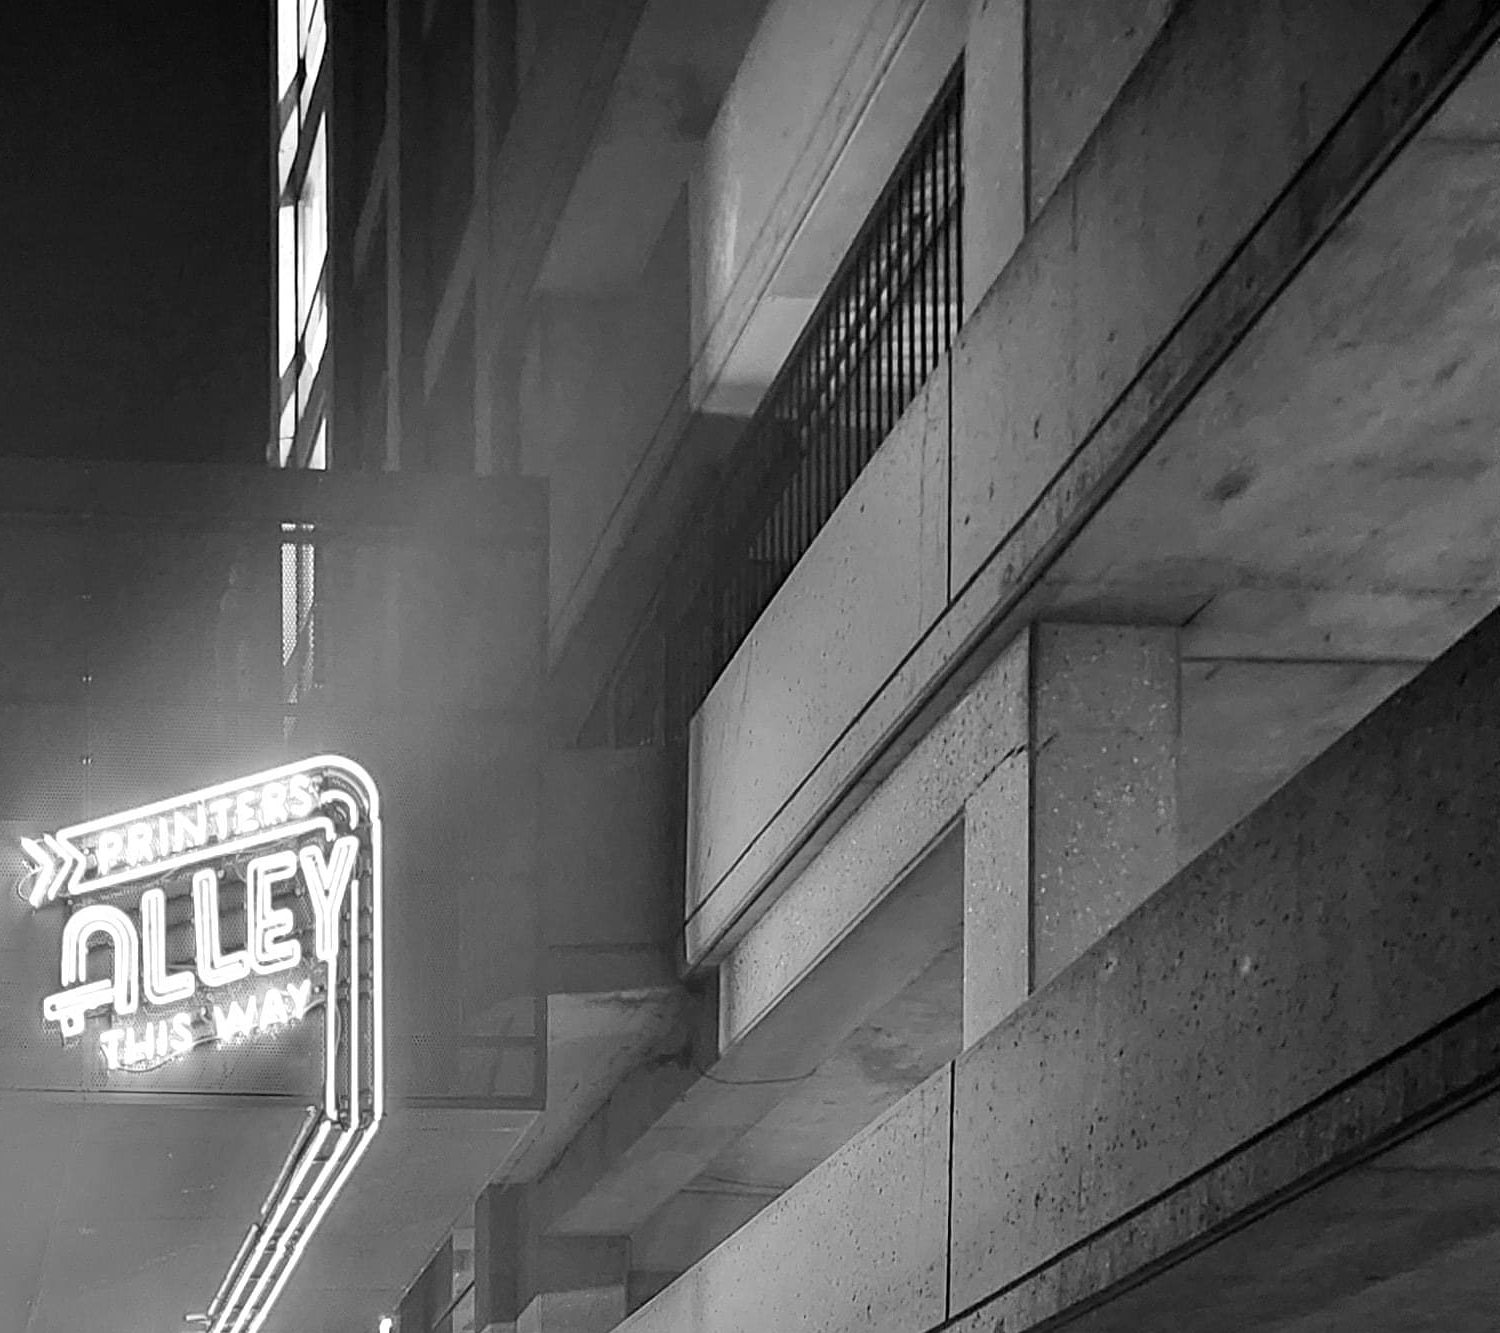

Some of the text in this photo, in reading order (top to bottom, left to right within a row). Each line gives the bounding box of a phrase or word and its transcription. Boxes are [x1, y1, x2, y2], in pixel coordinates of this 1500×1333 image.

[96, 774, 313, 874] PRINTERS
[43, 836, 359, 1038] ALLEY
[101, 980, 311, 1070] THIS WAY
